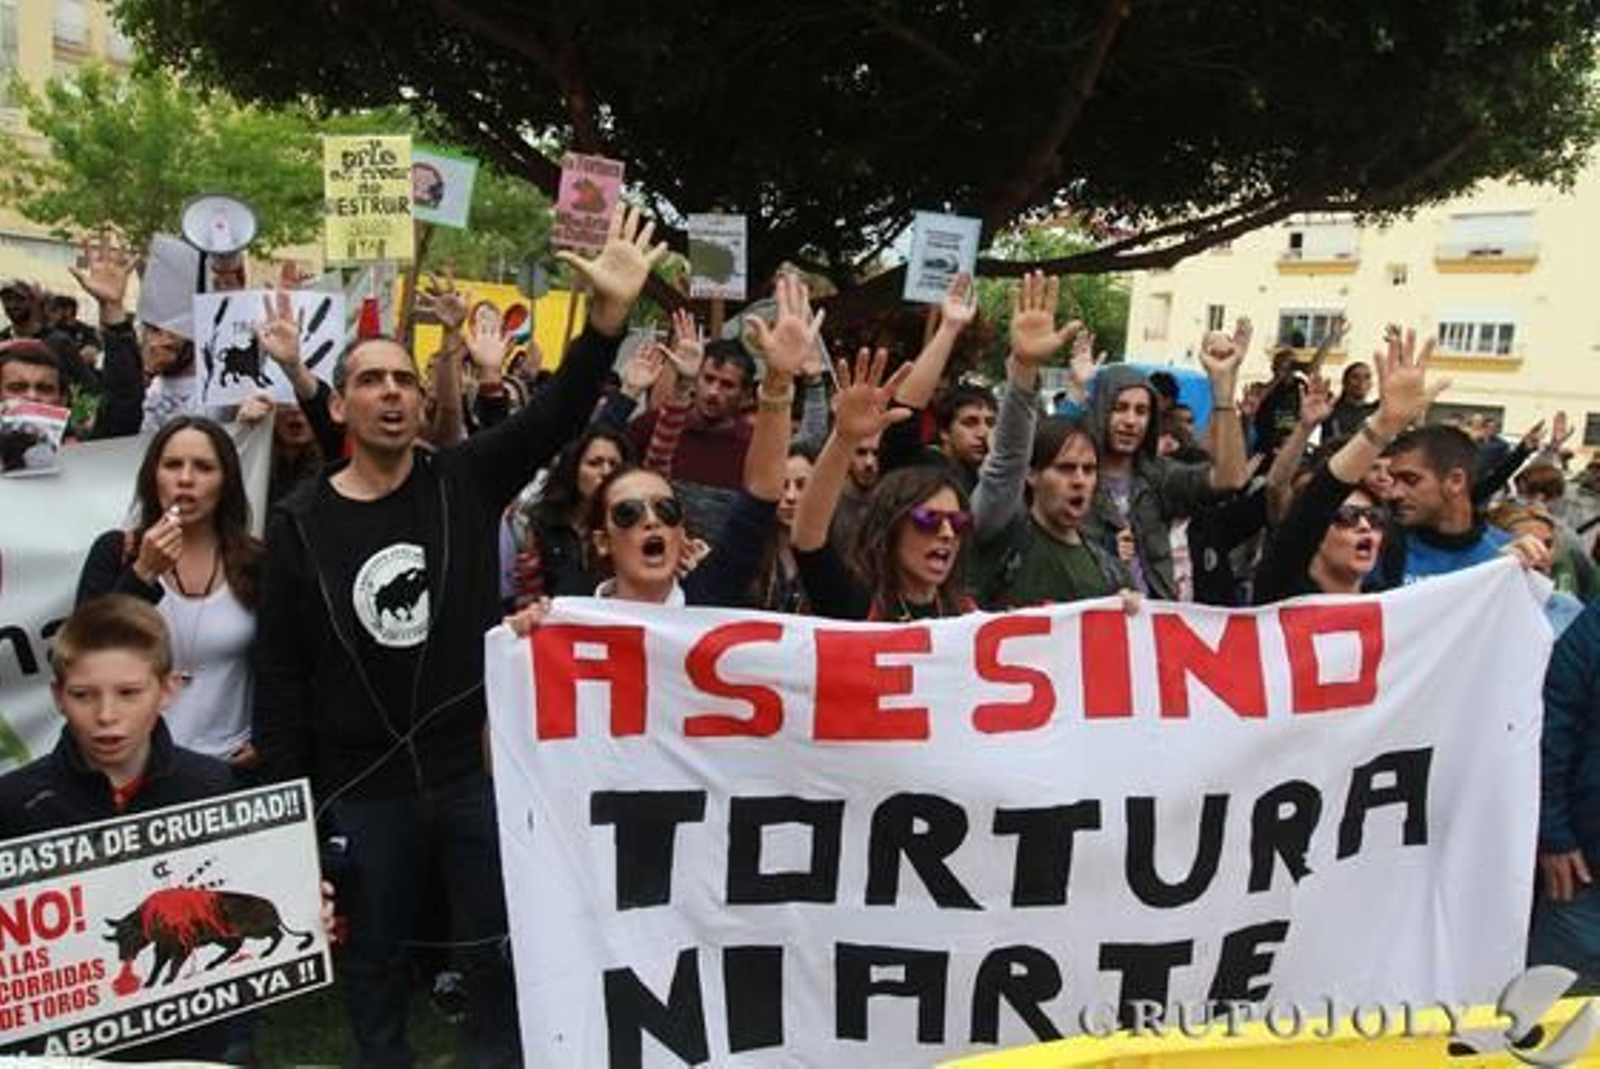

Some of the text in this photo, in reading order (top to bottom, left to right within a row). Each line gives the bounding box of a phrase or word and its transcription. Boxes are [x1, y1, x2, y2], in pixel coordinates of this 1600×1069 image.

[531, 603, 1384, 742] ASESINO
[0, 790, 301, 878] BASTA DE CRUELDAD!!
[590, 747, 1434, 911] TORTURA
[0, 885, 85, 949] NO!
[0, 959, 105, 1005] CORRIDAS
[11, 948, 49, 975] LAS
[604, 920, 1290, 1069] NI ARTE
[0, 984, 99, 1031] DE TOROS
[45, 983, 239, 1057] ABOLICIÓN
[248, 968, 290, 998] YA
